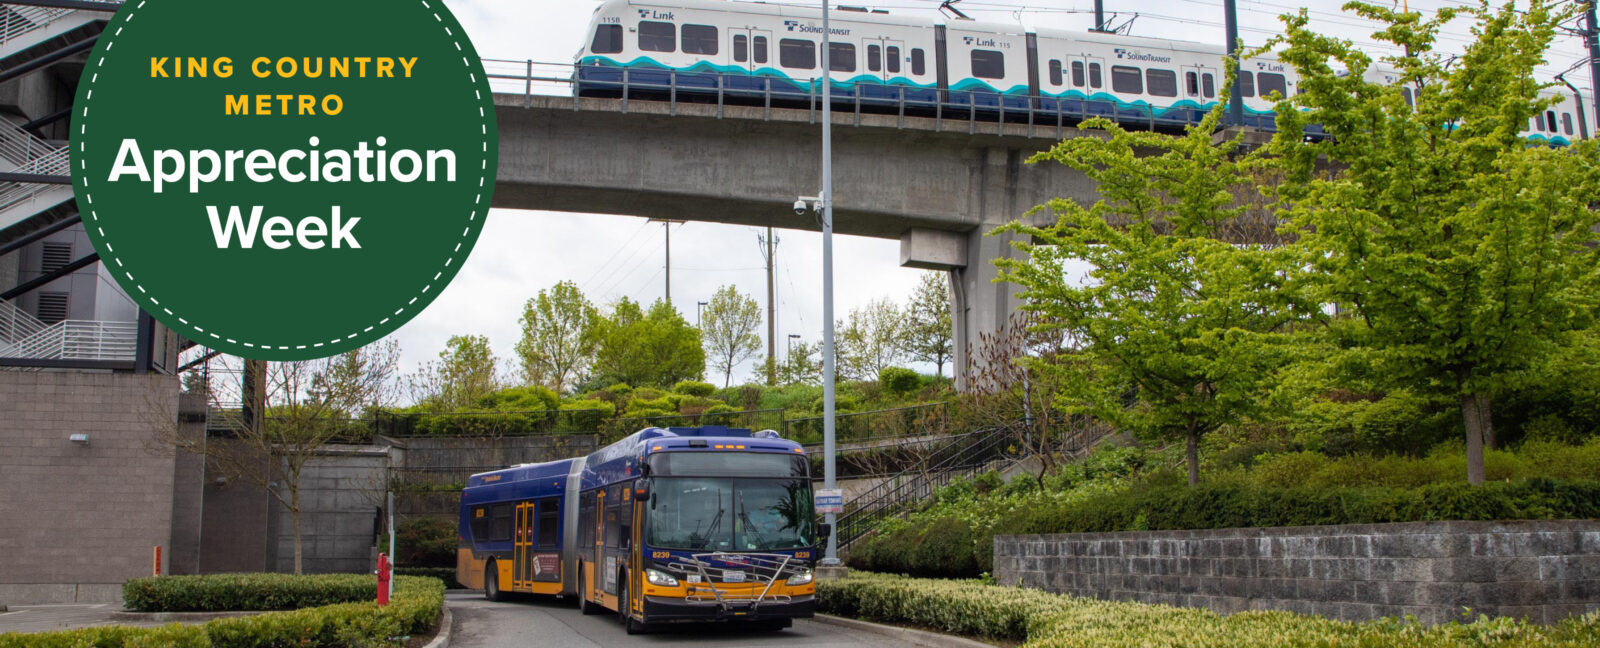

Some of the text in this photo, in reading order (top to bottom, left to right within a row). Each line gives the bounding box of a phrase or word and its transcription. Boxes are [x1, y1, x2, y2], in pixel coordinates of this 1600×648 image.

[653, 10, 675, 21] Link
[976, 37, 996, 48] Link
[1268, 63, 1285, 72] Link
